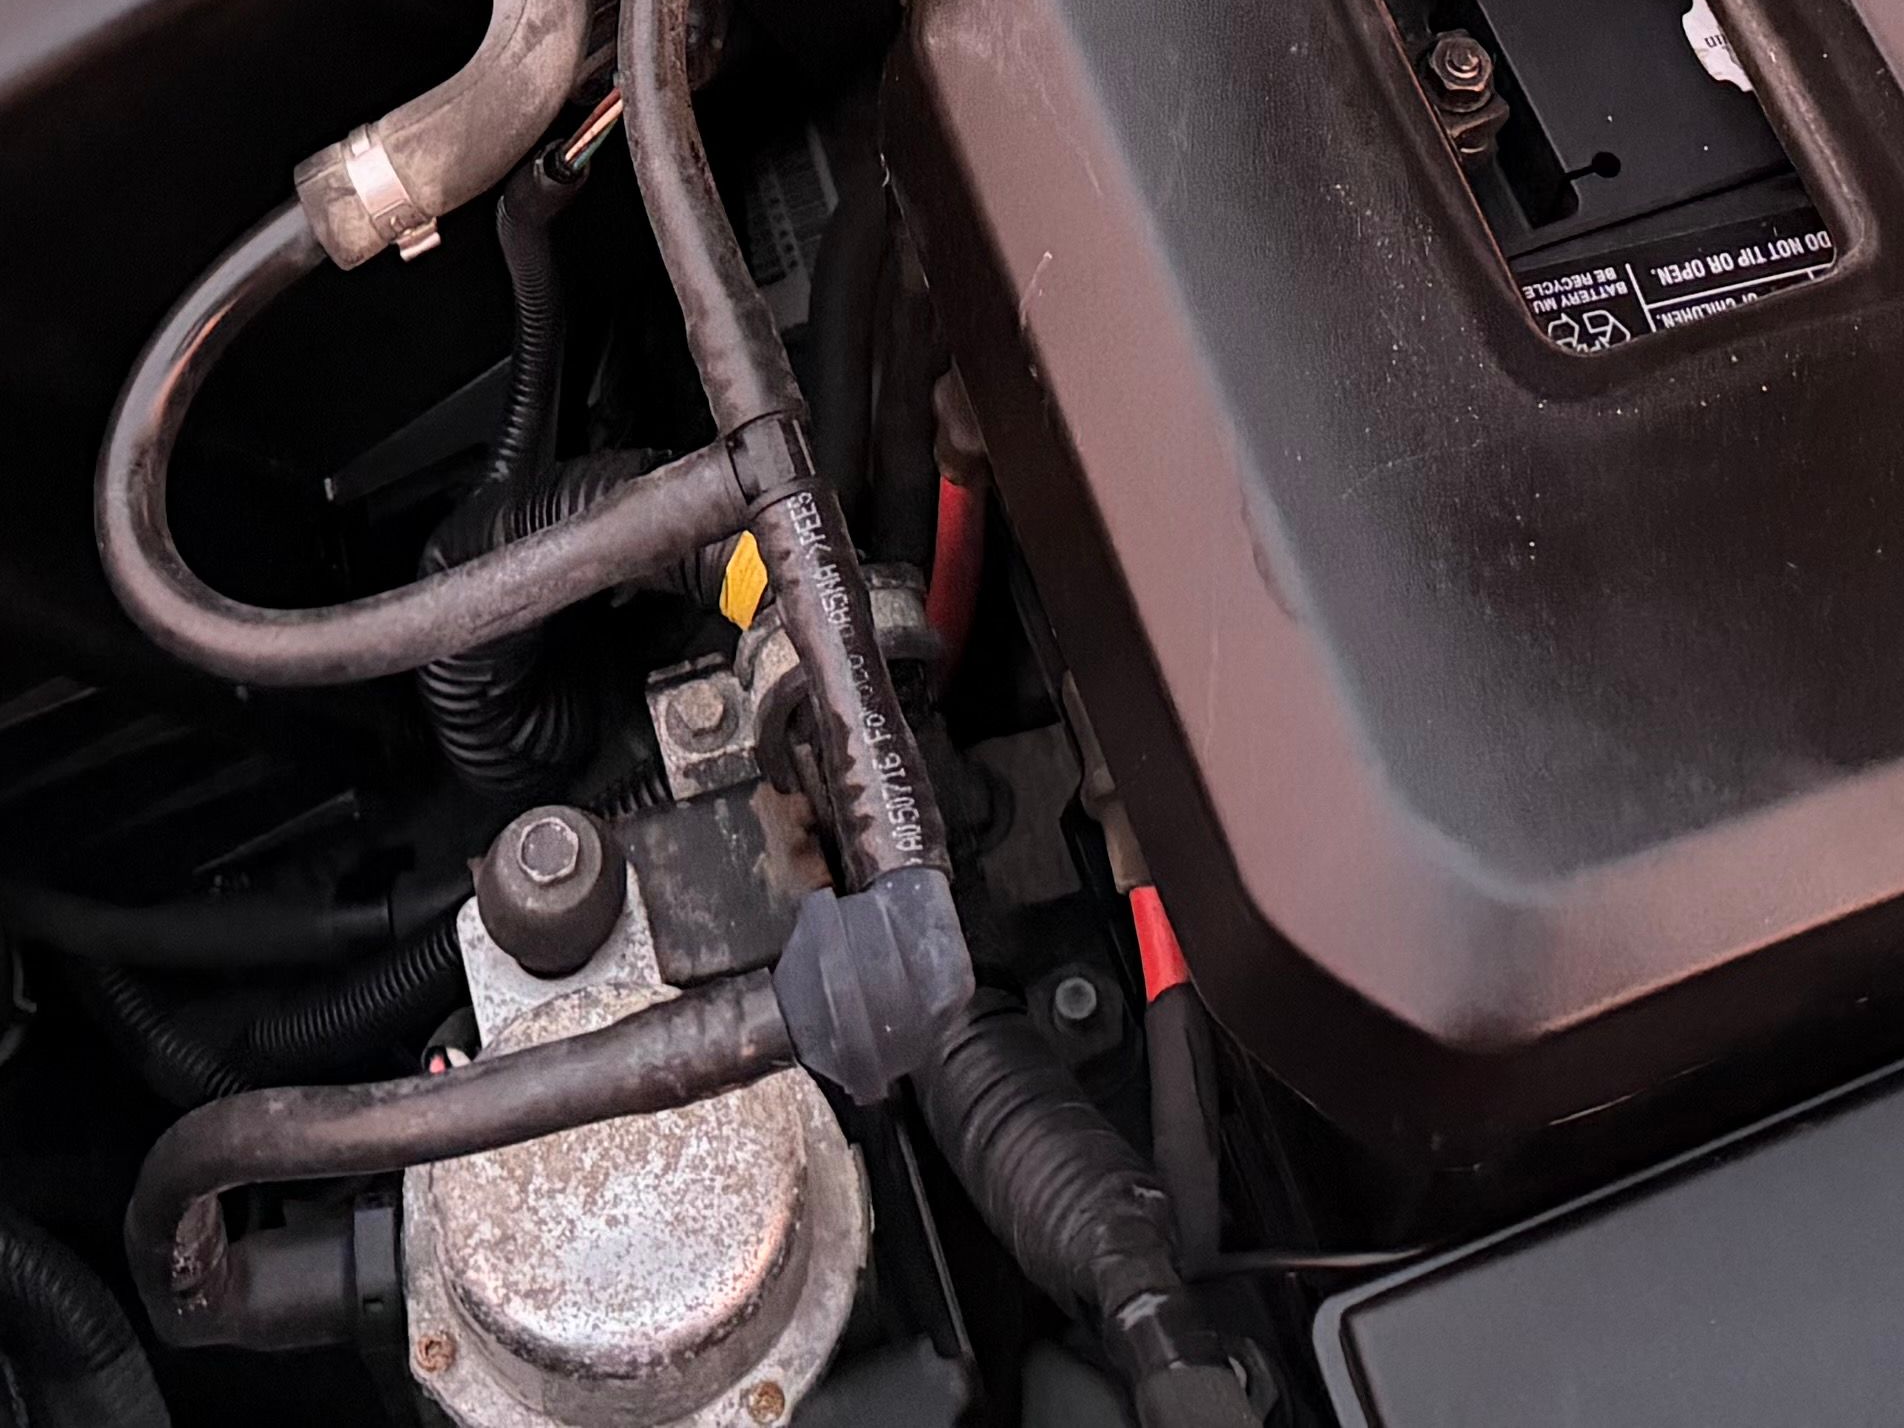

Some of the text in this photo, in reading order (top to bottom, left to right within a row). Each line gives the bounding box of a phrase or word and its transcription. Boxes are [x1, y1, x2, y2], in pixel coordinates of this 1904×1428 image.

[1650, 230, 1832, 286] DO NOT TIP OR OPEN.
[1522, 267, 1616, 298] BE RECYCLE
[1533, 281, 1628, 315] BATTERY MU
